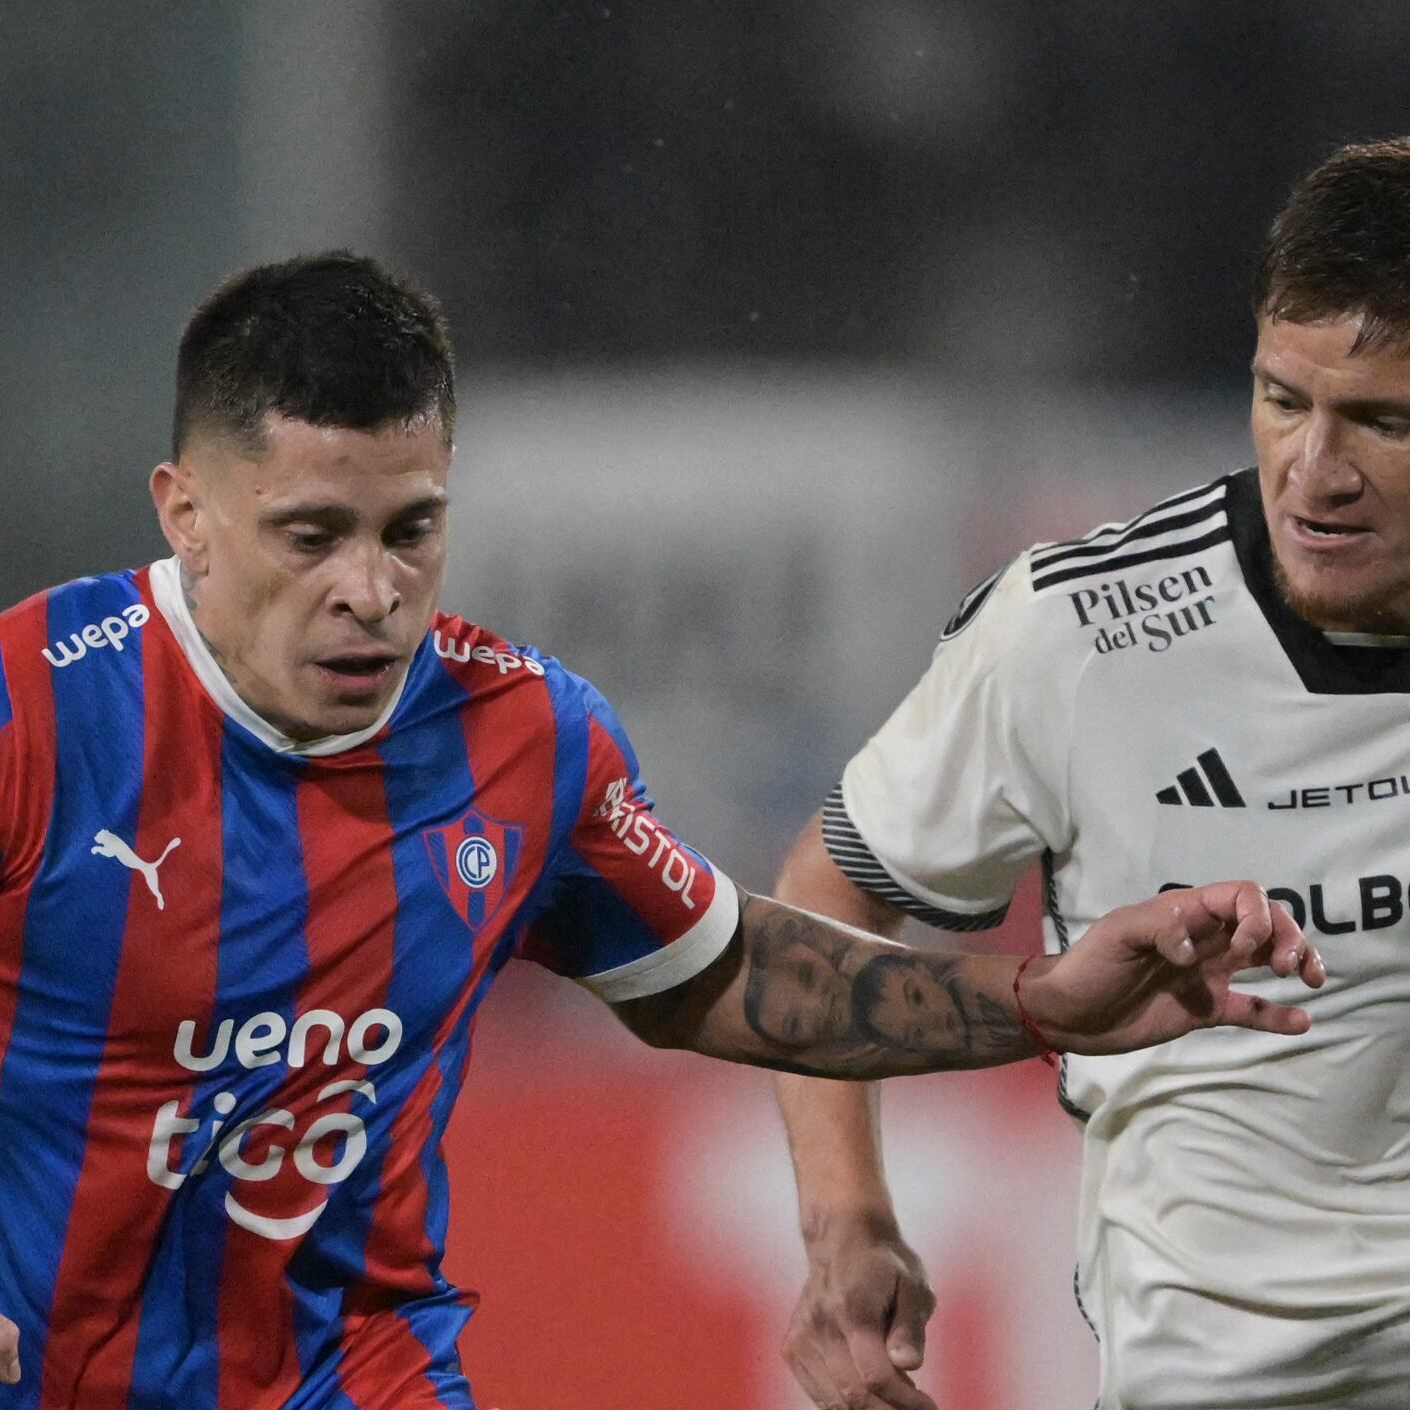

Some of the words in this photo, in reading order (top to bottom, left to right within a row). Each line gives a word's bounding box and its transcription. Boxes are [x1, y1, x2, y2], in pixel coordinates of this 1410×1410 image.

[1067, 564, 1214, 627] Pilsen
[1093, 622, 1138, 654] del
[1143, 595, 1217, 653] Sur
[41, 603, 151, 668] wepa
[433, 630, 545, 675] wepa
[173, 1008, 403, 1072] ueno
